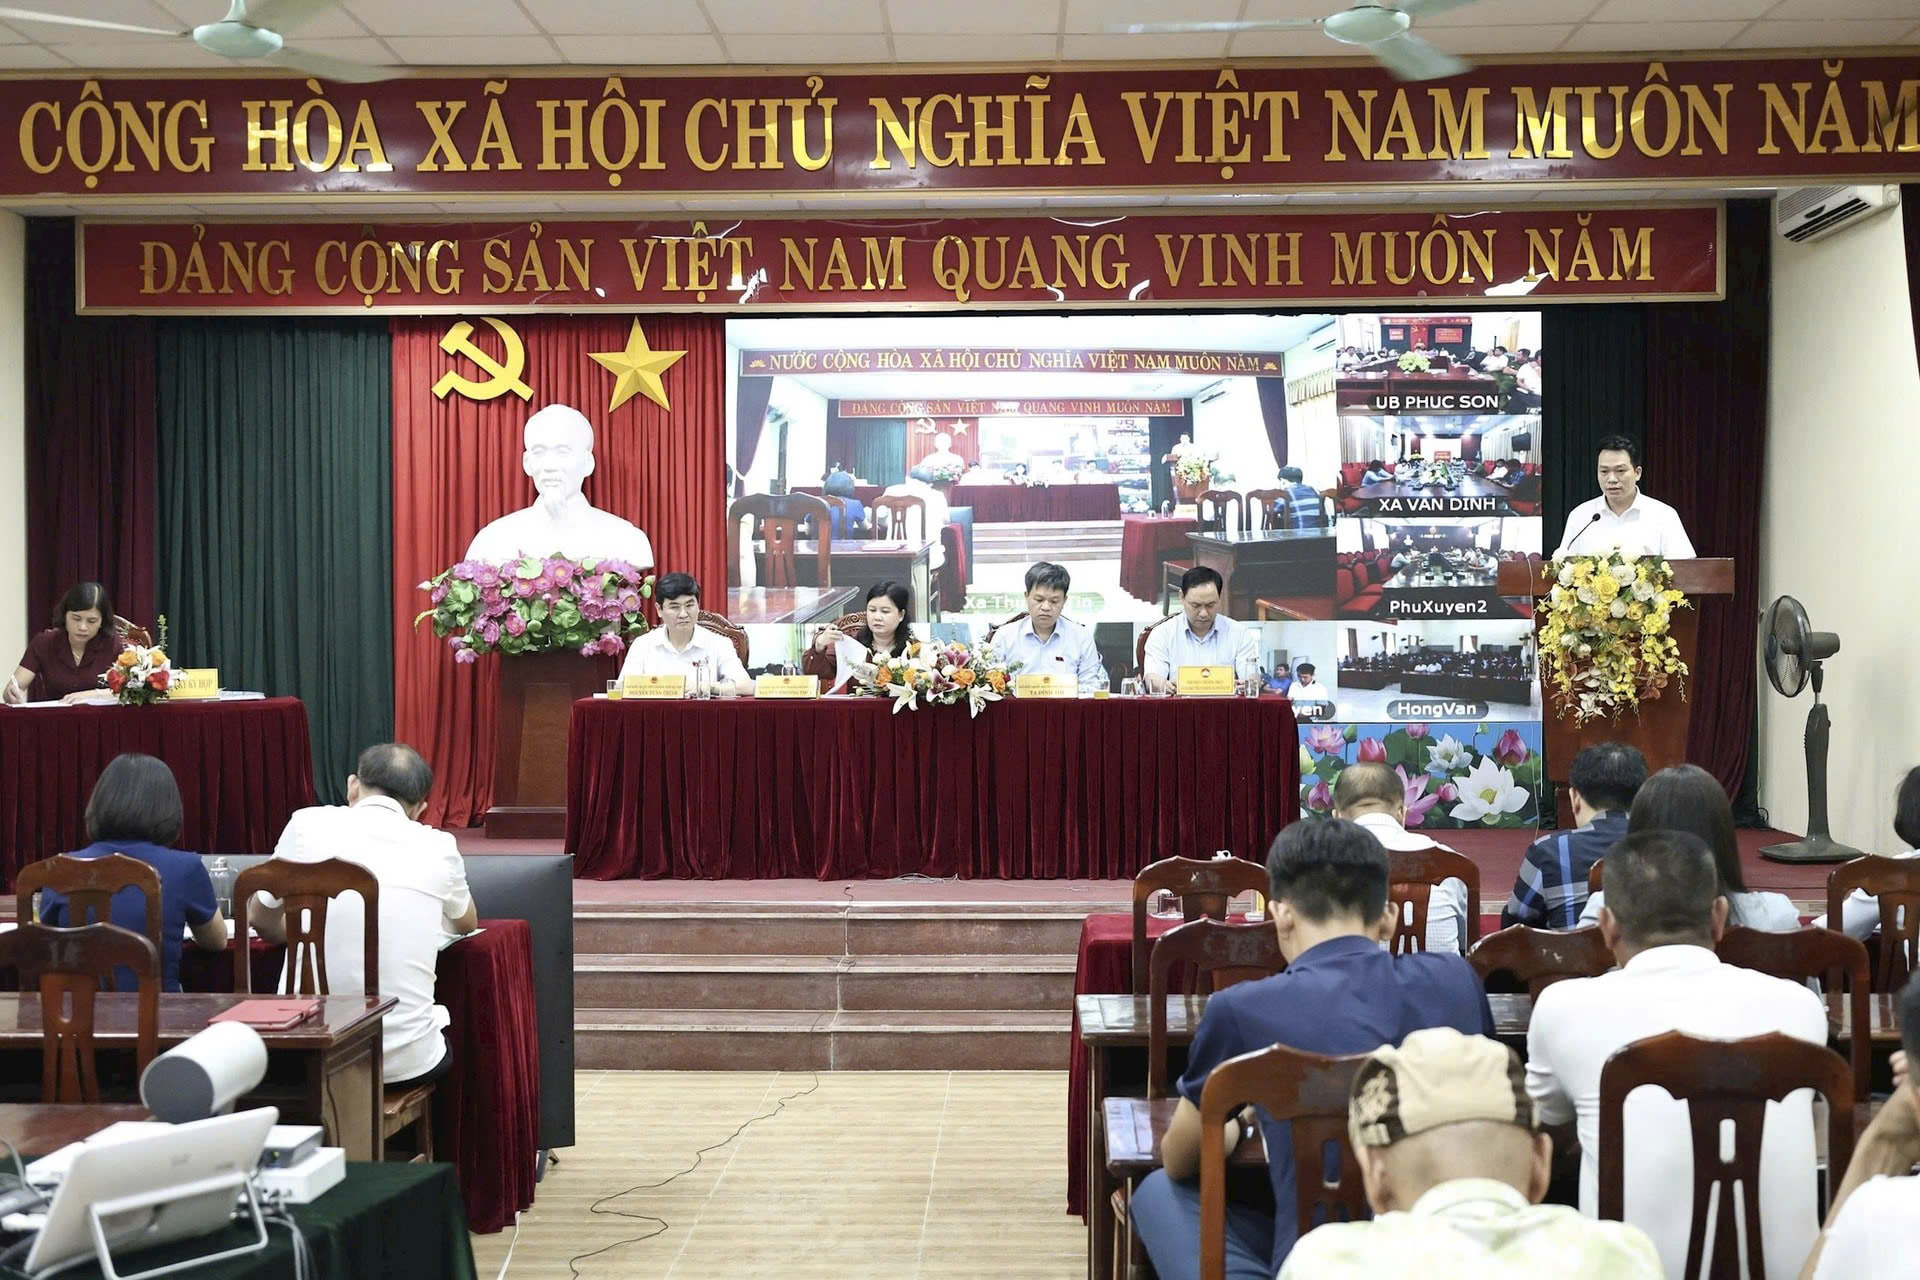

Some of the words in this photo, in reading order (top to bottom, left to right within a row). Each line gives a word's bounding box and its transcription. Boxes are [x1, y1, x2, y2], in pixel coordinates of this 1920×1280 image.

[19, 80, 215, 188] CỘNG
[241, 78, 394, 172] HÒA
[415, 79, 522, 172] XÃ
[536, 77, 667, 187] HỘI
[684, 75, 838, 171] CHỦ
[869, 75, 1106, 169] NGHĨA
[1121, 69, 1300, 180] VIỆT
[1324, 86, 1491, 162] NAM
[1509, 62, 1734, 160] MUÔN
[1758, 59, 1920, 155] NĂM
[139, 223, 297, 295] ĐẢNG
[315, 223, 464, 307] CỘNG
[482, 221, 595, 294] SẢN
[620, 220, 754, 303] VIỆT
[780, 237, 906, 291] NAM
[932, 235, 1131, 303] QUANG
[1155, 232, 1303, 288] VINH
[1331, 213, 1494, 286] MUÔN
[1523, 212, 1655, 283] NĂM
[769, 350, 817, 370] NƯỚC
[823, 348, 871, 372] CỘNG
[876, 347, 914, 369] HÒA
[920, 348, 945, 369] XÃ
[948, 347, 980, 372] HỘI
[984, 346, 1022, 369] CHỦ
[1028, 349, 1085, 369] NGHĨA
[1088, 348, 1129, 373] VIỆT
[1133, 354, 1171, 370] NAM
[1175, 351, 1222, 371] MUÔN
[1226, 352, 1261, 372] NĂM
[1023, 401, 1065, 415] QUANG
[1070, 401, 1100, 413] VINH
[1376, 396, 1400, 409] UB
[1405, 395, 1455, 409] PHUC
[1459, 395, 1499, 409] SON
[1379, 498, 1403, 512] XA
[1407, 498, 1444, 511] VAN
[1449, 498, 1496, 511] DINH
[1390, 600, 1488, 616] PhuXuyen2
[1398, 702, 1477, 718] HongVan
